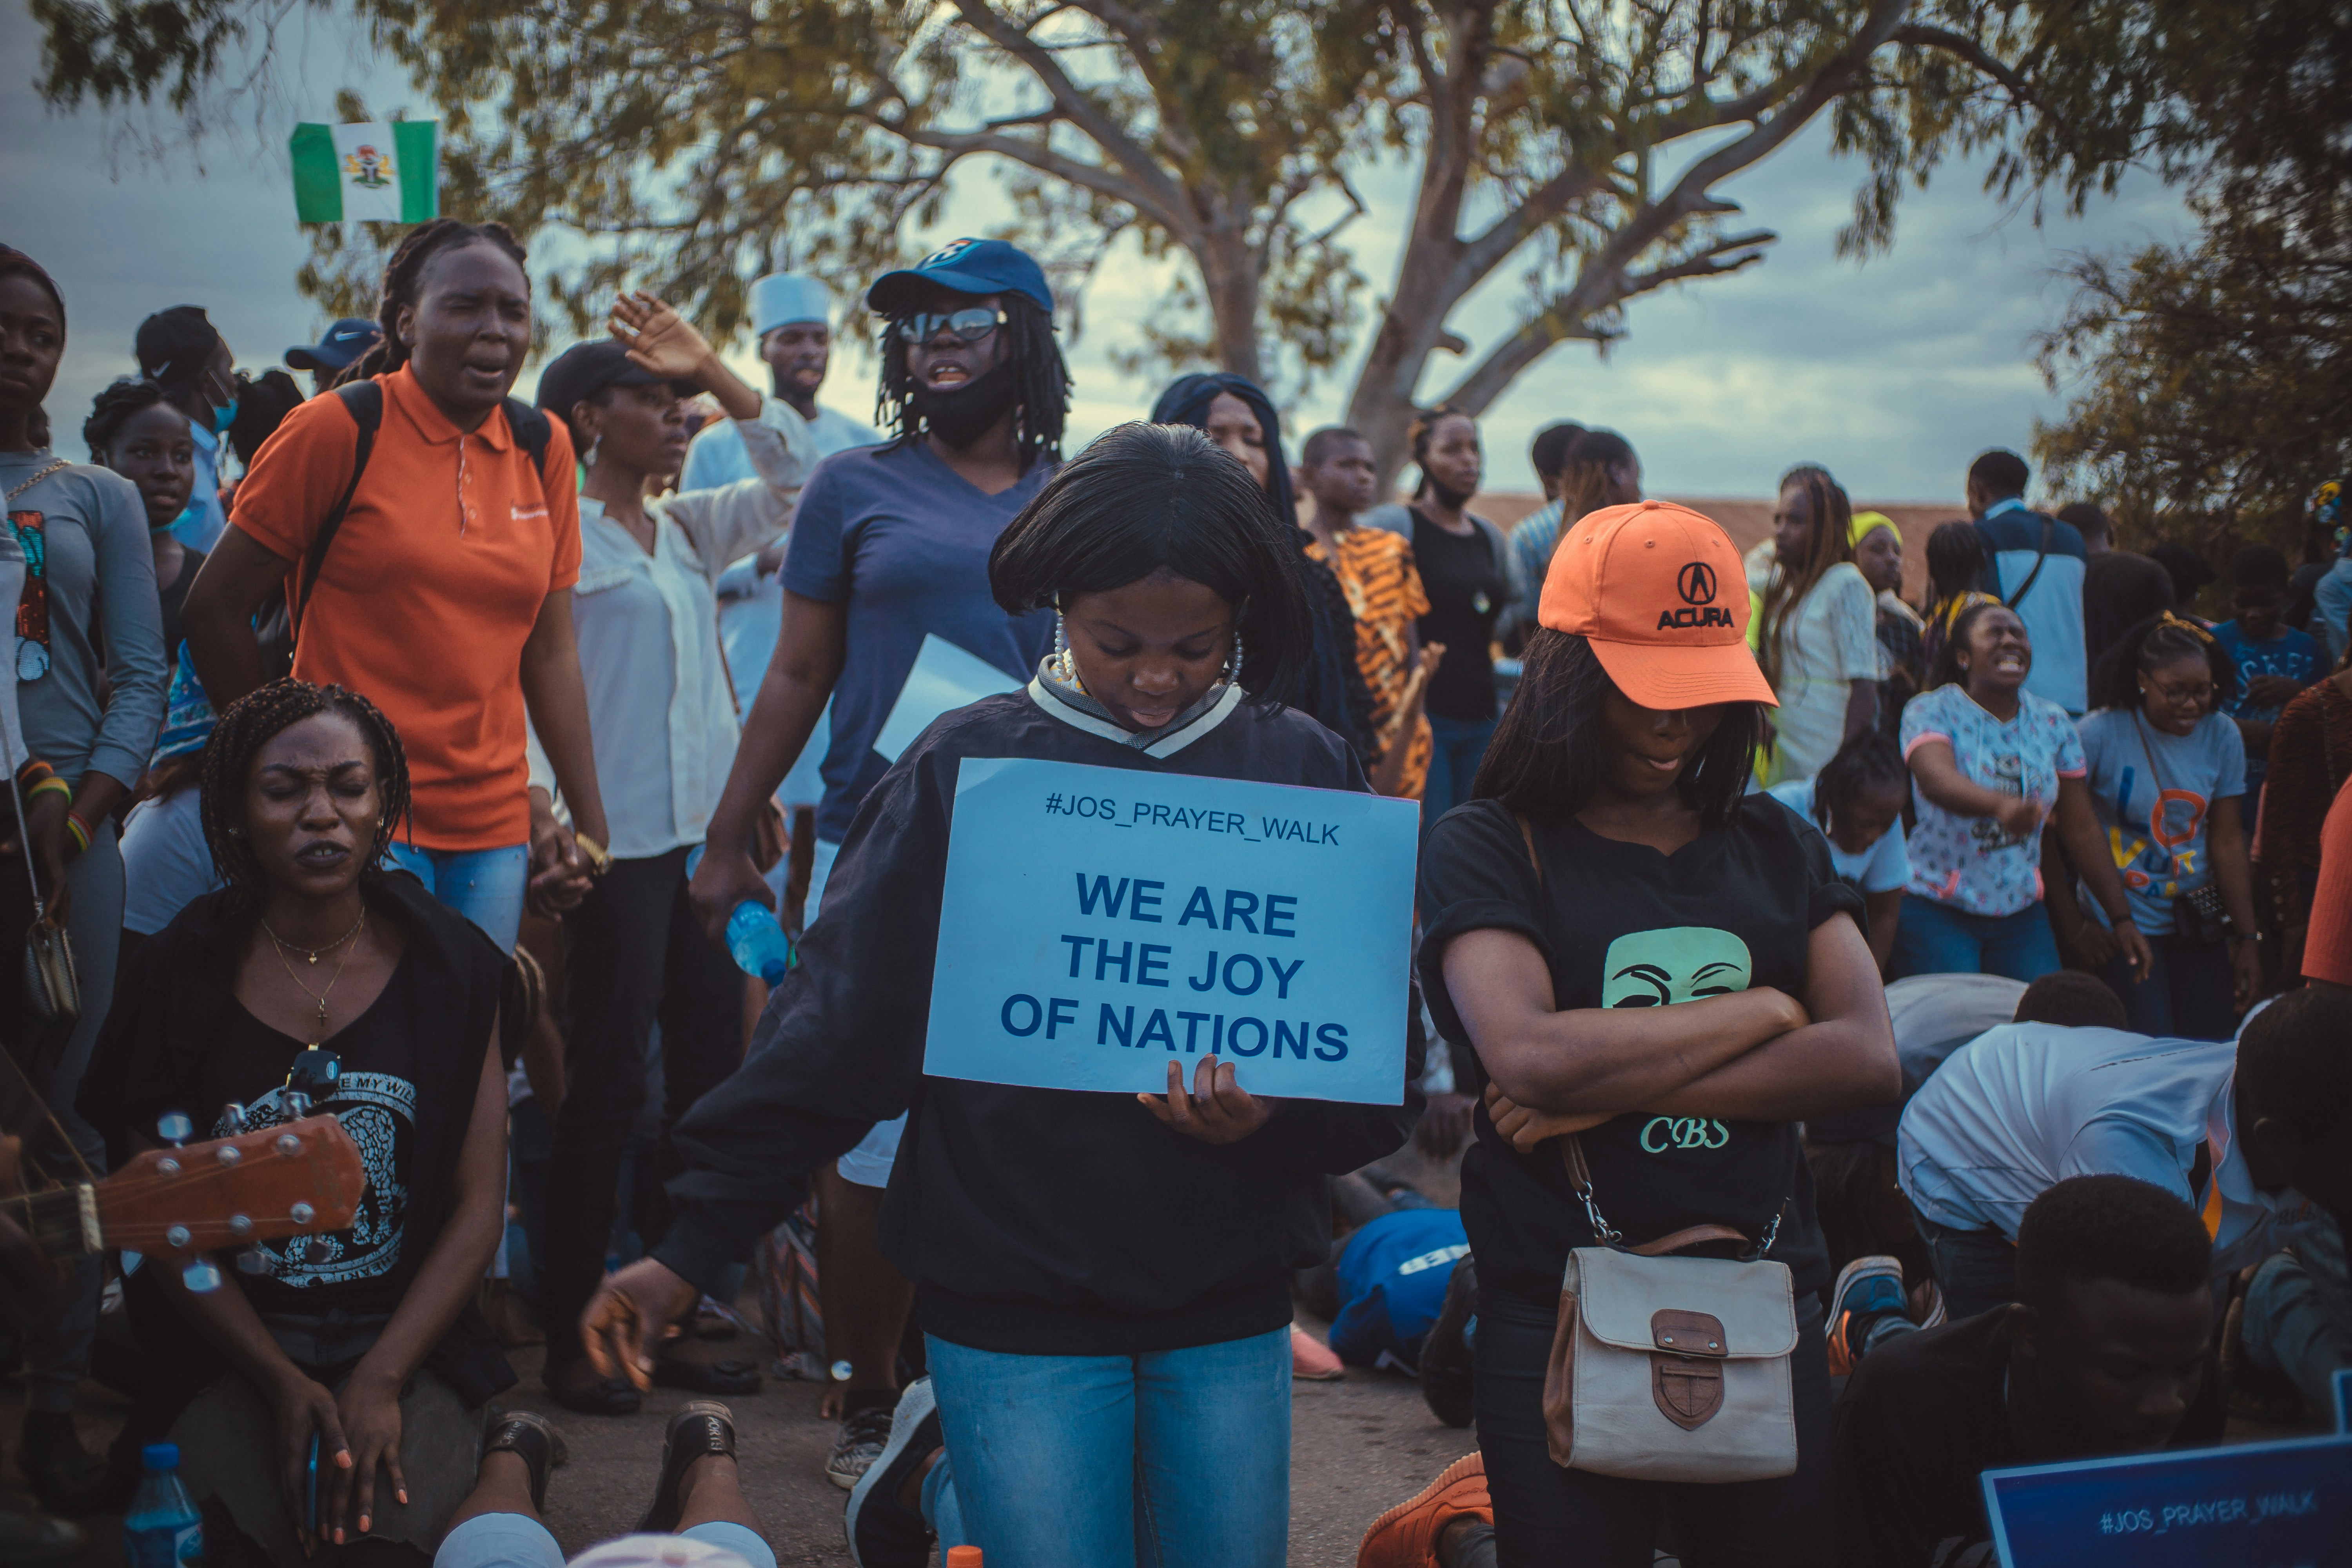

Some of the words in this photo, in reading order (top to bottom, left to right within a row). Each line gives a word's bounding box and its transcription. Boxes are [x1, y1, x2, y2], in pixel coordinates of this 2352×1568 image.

[1657, 607, 1735, 630] ACURA
[1045, 792, 1340, 846] #JOS_PRAYER_WALK
[1076, 873, 1165, 923] WE
[1177, 886, 1298, 938] ARE
[1060, 934, 1172, 988] THE
[1188, 950, 1305, 1000] JOY
[1001, 993, 1080, 1040] OF
[1097, 1002, 1349, 1062] NATIONS
[357, 1076, 382, 1089] MY
[1640, 1116, 1730, 1153] CBS
